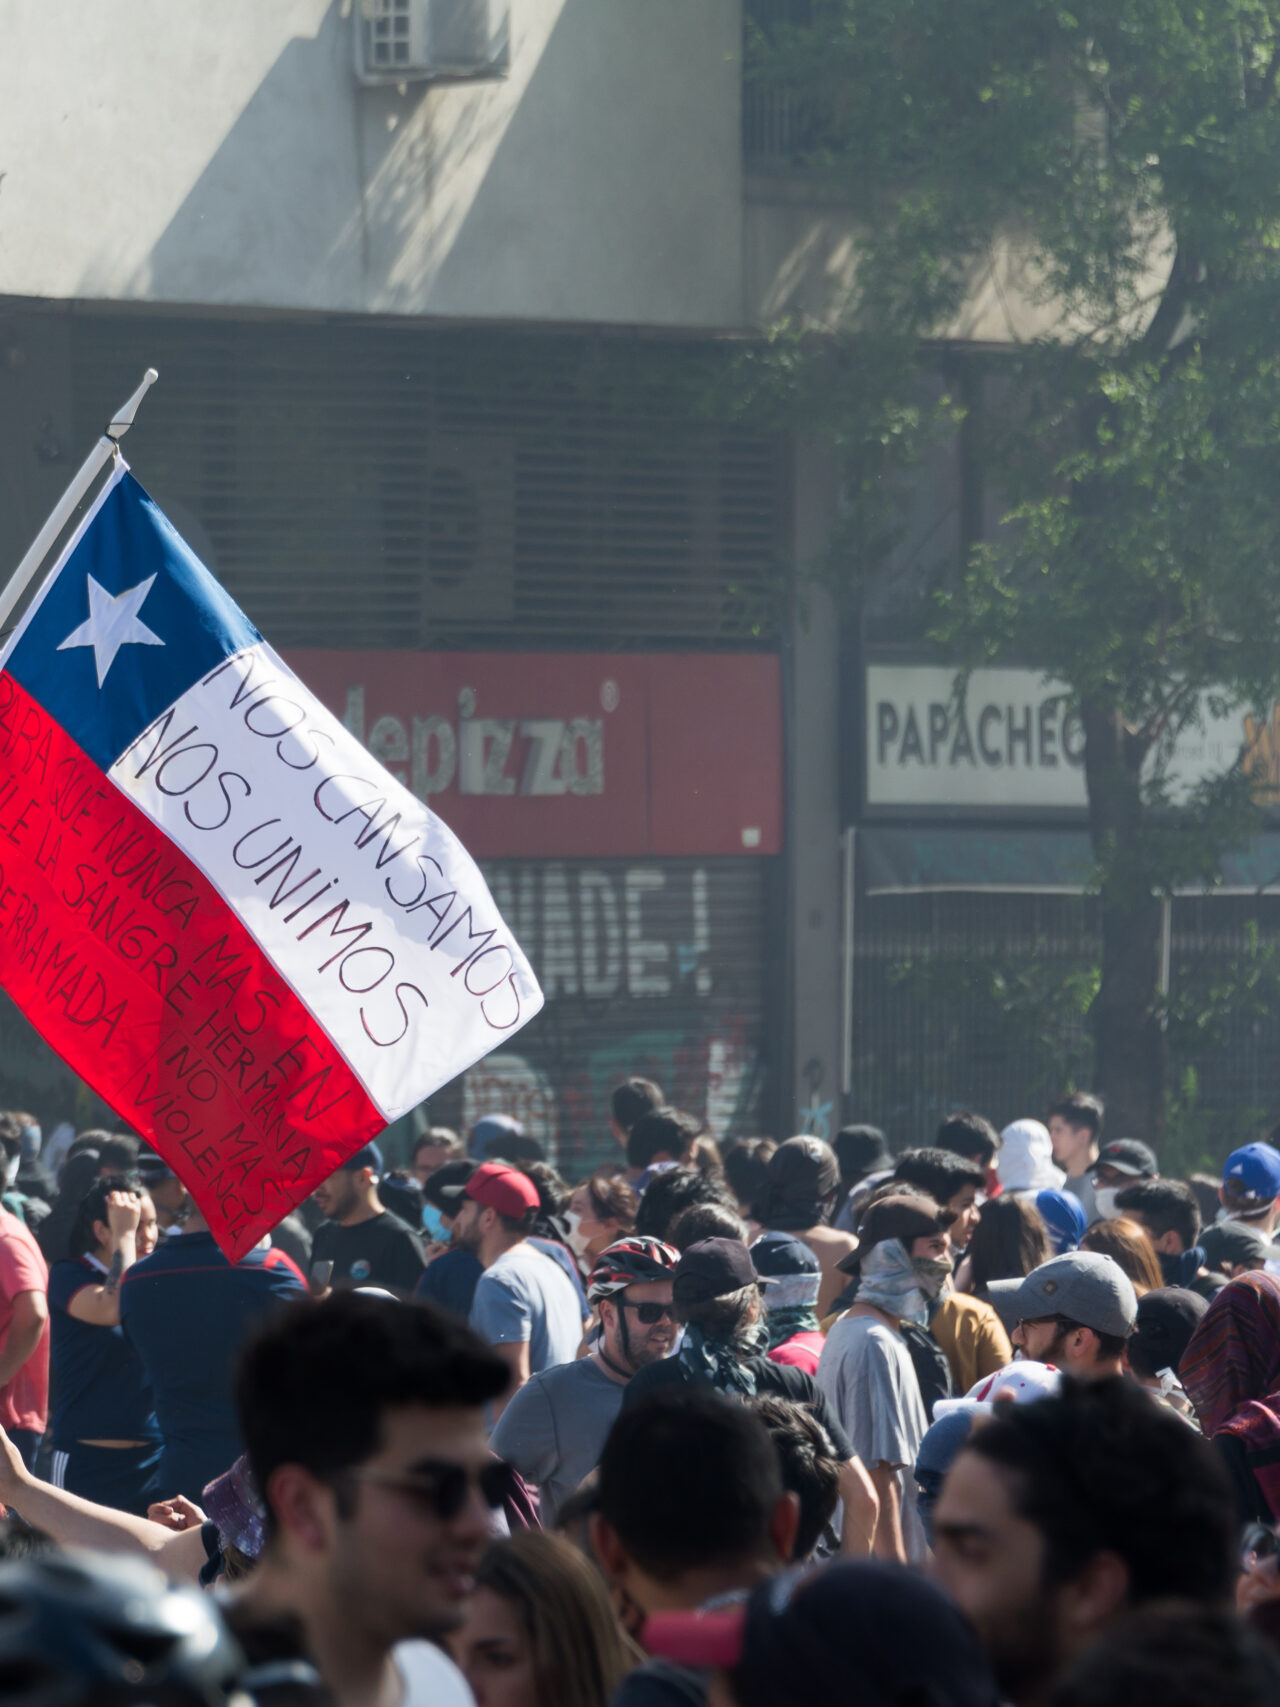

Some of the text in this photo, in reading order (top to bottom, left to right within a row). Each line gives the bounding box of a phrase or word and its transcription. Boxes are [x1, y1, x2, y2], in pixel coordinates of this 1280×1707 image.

[115, 708, 252, 831] NOS
[201, 652, 336, 770] NOS
[313, 774, 521, 1030] CANSAMOS
[34, 818, 62, 882] LA
[62, 863, 203, 1019] SANGRE
[193, 1009, 311, 1184] HERMANA
[91, 815, 200, 931] NUNCA
[193, 933, 281, 1036] MAS
[272, 1034, 352, 1122] EN
[165, 1044, 282, 1216] NO MAS
